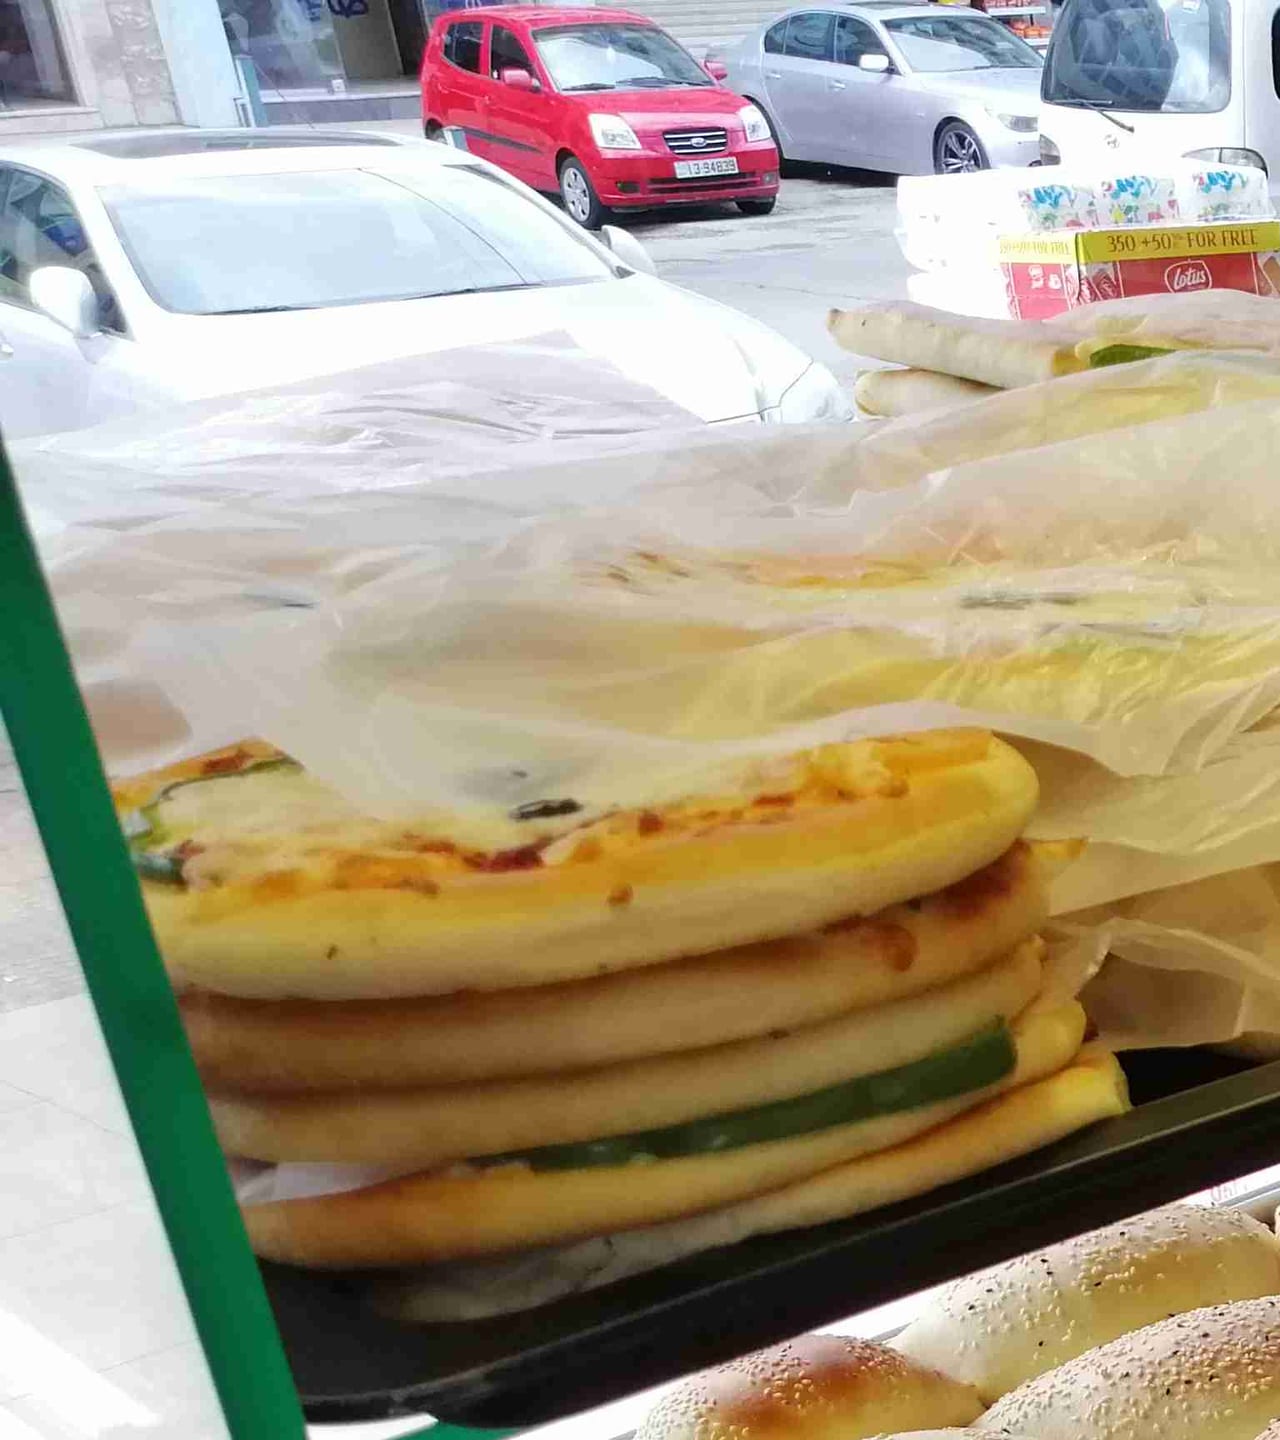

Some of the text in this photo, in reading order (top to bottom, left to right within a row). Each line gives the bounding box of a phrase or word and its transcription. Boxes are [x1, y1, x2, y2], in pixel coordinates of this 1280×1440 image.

[1106, 234, 1136, 253] 350
[1186, 231, 1214, 249] FOR
[1221, 228, 1259, 248] FREE
